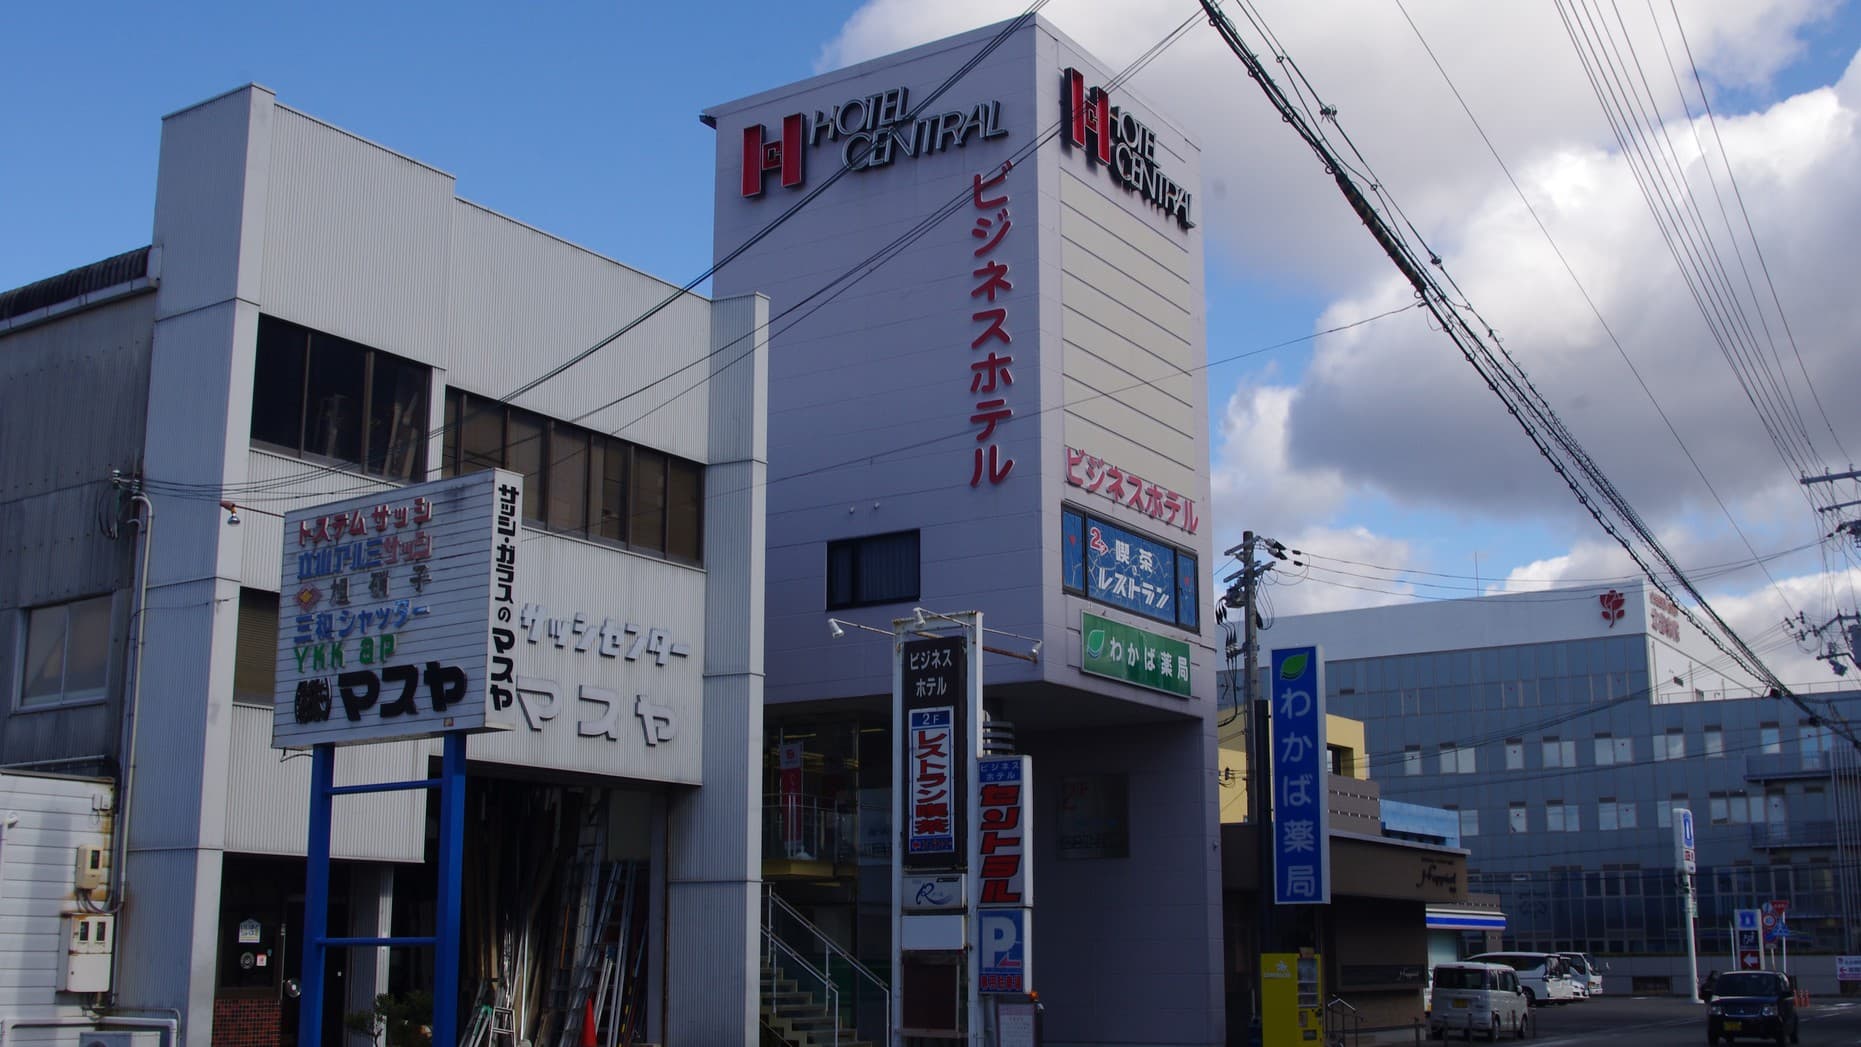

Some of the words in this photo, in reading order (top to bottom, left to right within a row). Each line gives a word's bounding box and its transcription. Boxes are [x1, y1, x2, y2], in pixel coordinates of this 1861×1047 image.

[810, 86, 911, 146] HOTEL
[841, 100, 1009, 171] CENTRAL
[1115, 142, 1196, 229] CENTRAL
[970, 159, 1015, 488] ビジネスホテル
[1065, 447, 1199, 534] ビジネスホテル
[1115, 539, 1153, 572] 喫茶
[1098, 567, 1170, 609] レストラン
[294, 599, 431, 644] 三和シャッター
[520, 602, 690, 667] サッシセンター
[293, 641, 345, 674] YKK
[359, 633, 397, 664] ap
[910, 648, 952, 670] ビジネス
[1109, 636, 1189, 682] わかば薬局
[515, 675, 678, 747] マスヤ
[916, 676, 947, 698] ホテル
[981, 761, 1020, 772] ビジネス
[1280, 687, 1315, 897] わかば薬局
[980, 784, 1021, 903] セントラル
[982, 916, 1017, 968] P
